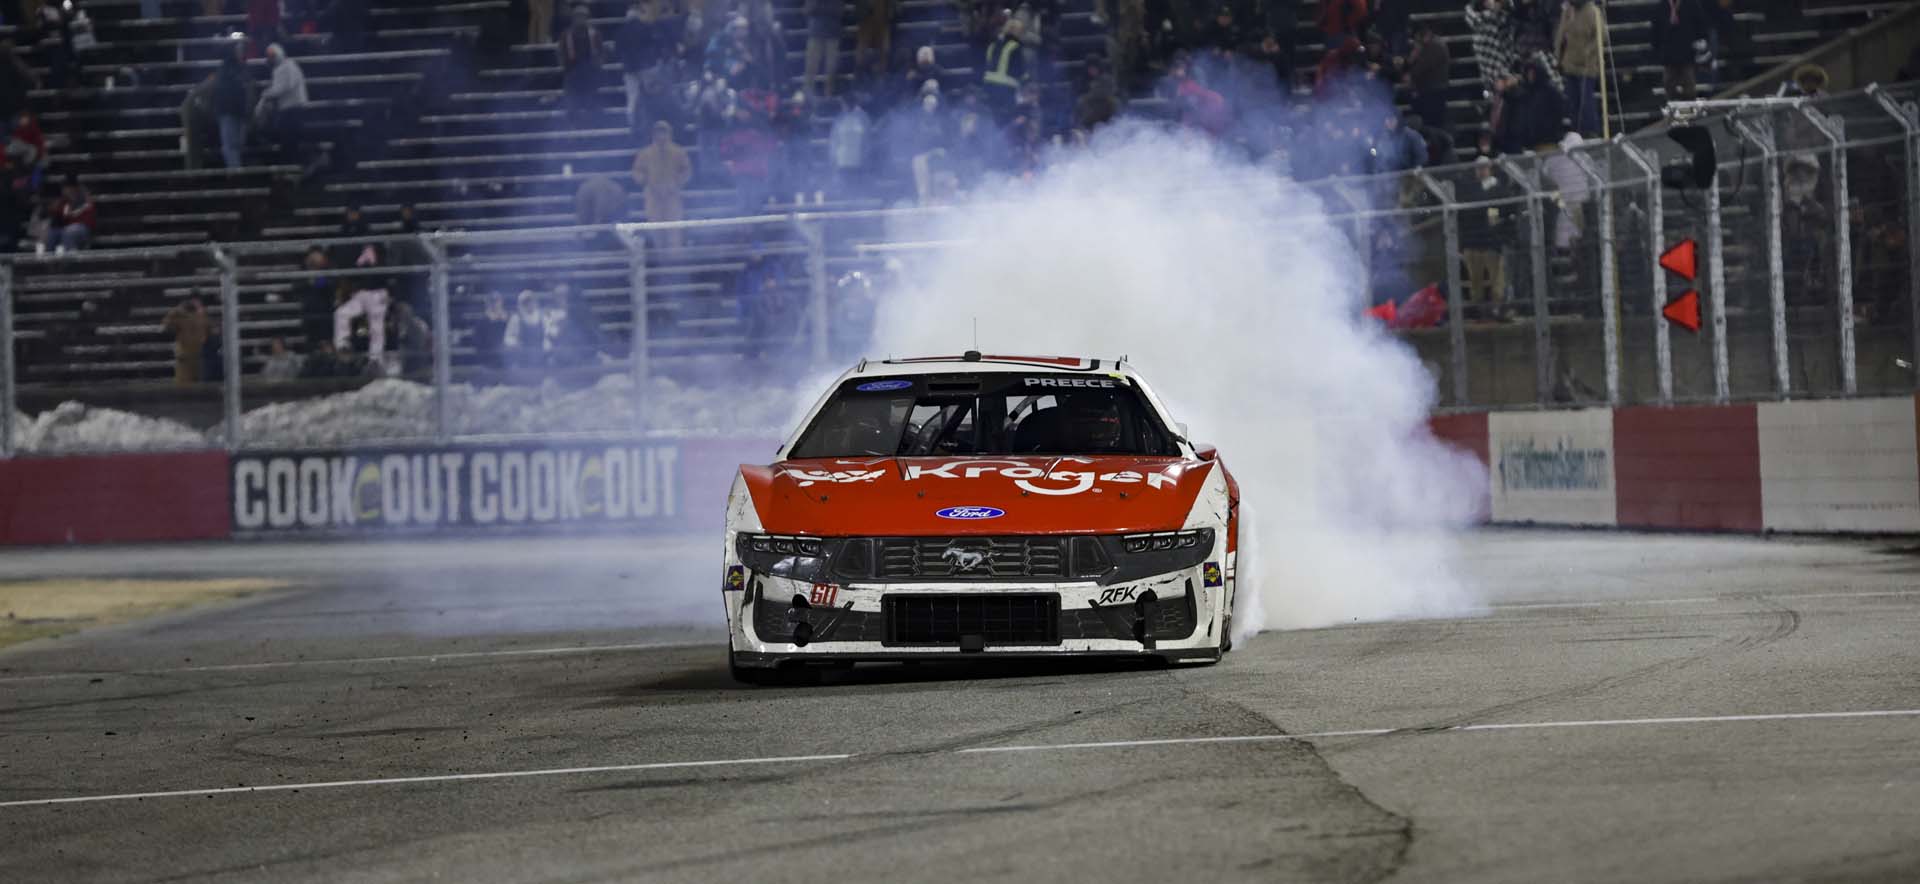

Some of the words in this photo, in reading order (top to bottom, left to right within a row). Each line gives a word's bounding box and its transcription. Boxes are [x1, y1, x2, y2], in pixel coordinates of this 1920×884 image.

[1024, 377, 1115, 388] PREECE
[234, 457, 358, 527] COOK
[381, 452, 465, 524] OUT
[470, 450, 582, 523] COOK
[604, 447, 678, 518] OUT
[904, 456, 1177, 496] Kroger
[1100, 585, 1138, 604] RFK
